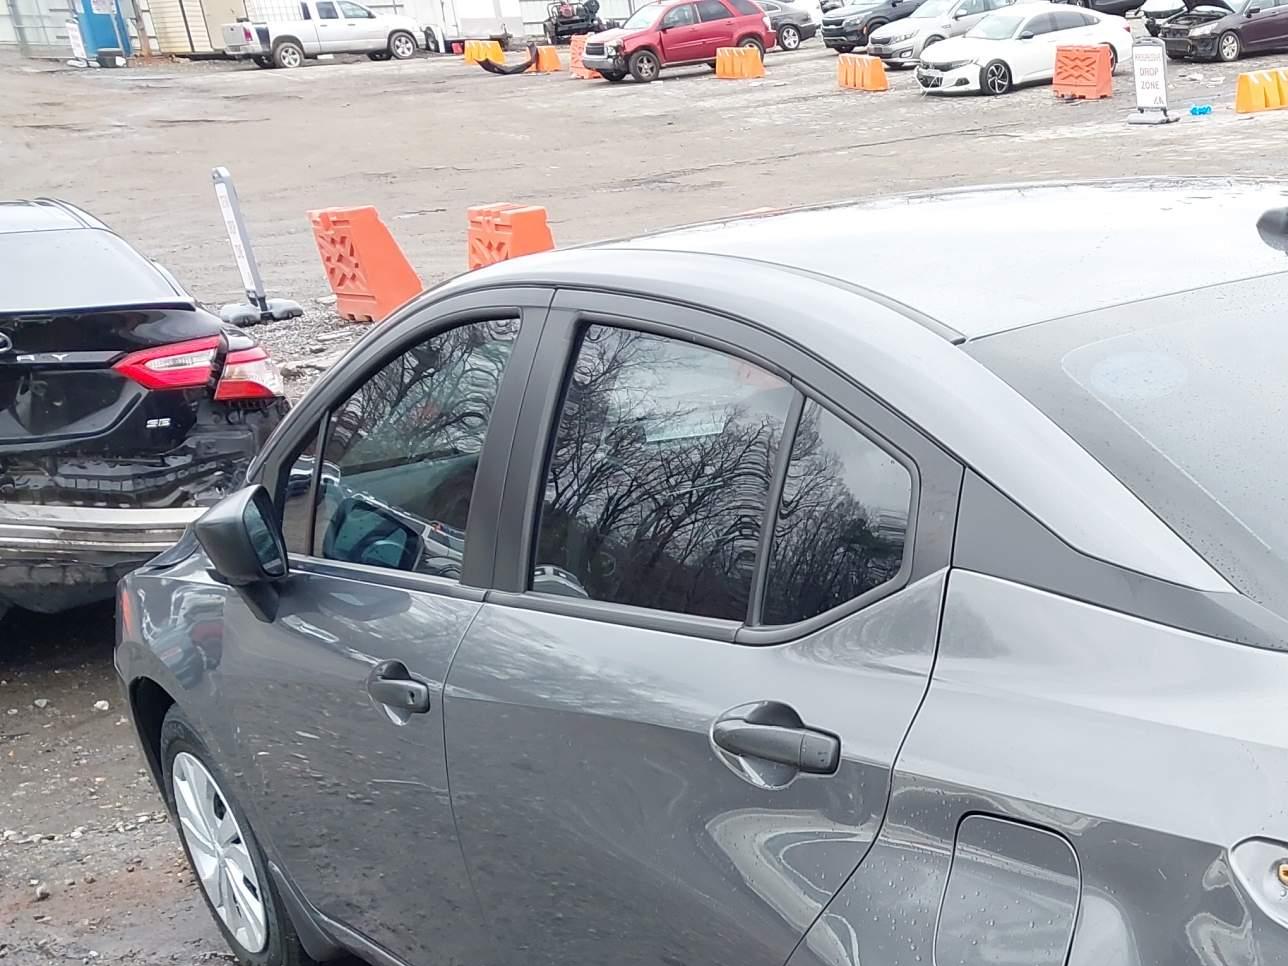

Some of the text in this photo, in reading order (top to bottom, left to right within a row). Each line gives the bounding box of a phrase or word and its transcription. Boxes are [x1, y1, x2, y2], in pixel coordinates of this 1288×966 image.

[1139, 67, 1159, 77] DROP
[1140, 80, 1161, 90] ZONE
[145, 417, 172, 429] SE
